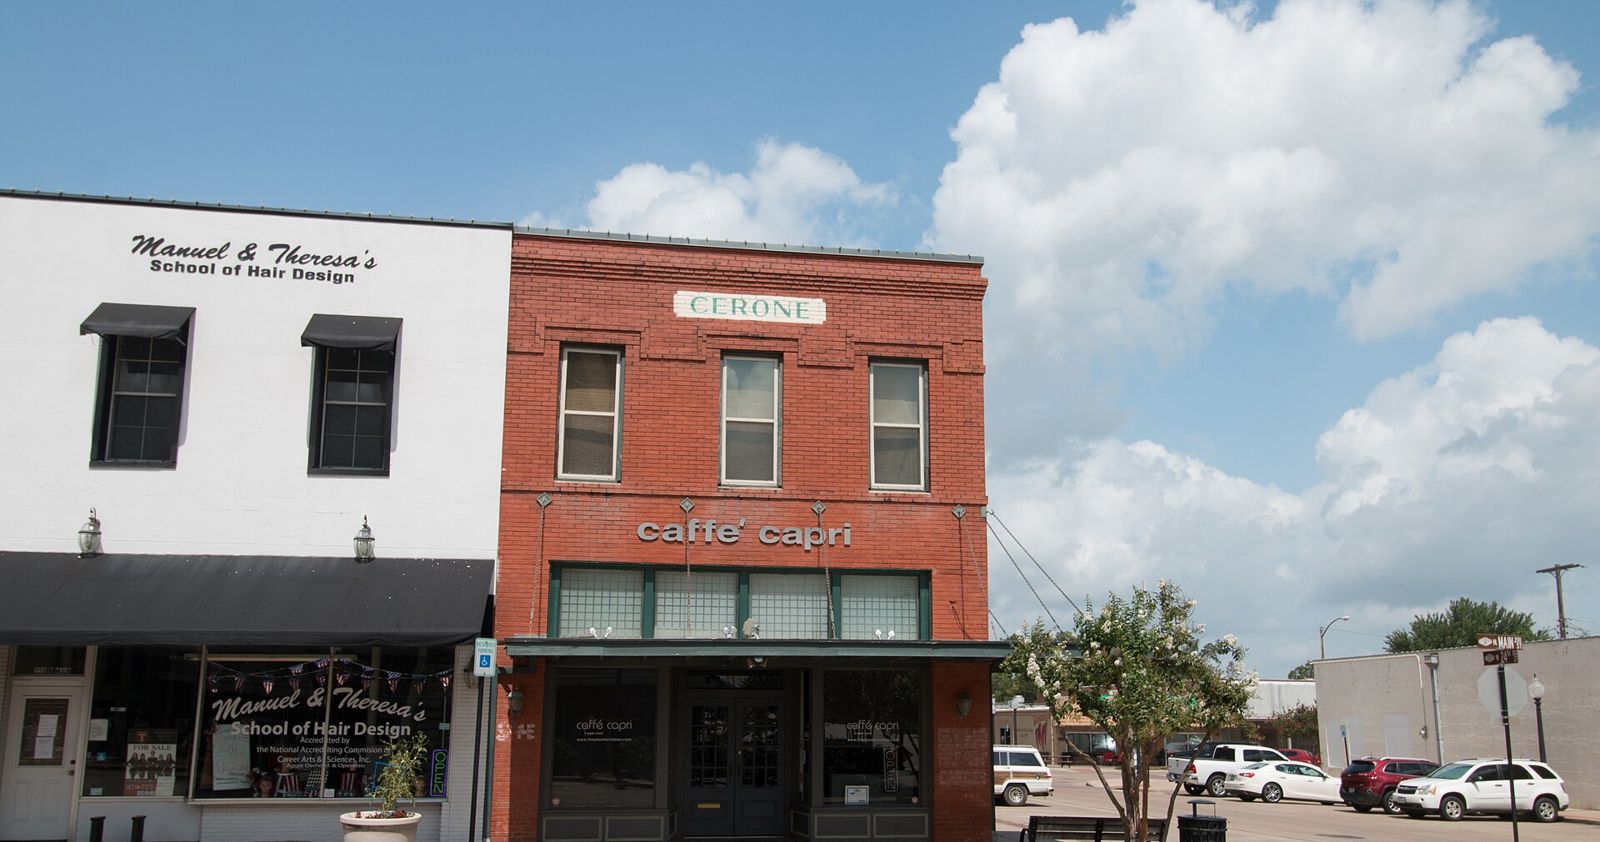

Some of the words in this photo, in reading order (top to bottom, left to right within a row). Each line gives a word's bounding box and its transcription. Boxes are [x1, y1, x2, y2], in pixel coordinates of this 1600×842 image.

[131, 234, 231, 260] Manuel
[237, 243, 258, 261] &
[268, 243, 378, 269] Theresa's
[150, 259, 215, 274] School
[222, 265, 242, 276] of
[248, 265, 286, 279] Hair
[293, 268, 355, 285] Design
[690, 295, 810, 320] CERONE
[759, 522, 852, 551] capri
[1498, 636, 1515, 649] MAIN
[212, 688, 300, 721] Manuel
[306, 687, 325, 707] &
[333, 687, 426, 721] Theresa's
[231, 721, 288, 735] School
[292, 721, 311, 735] of
[314, 722, 350, 735] Hair
[354, 722, 411, 739] Design
[606, 719, 633, 732] capri
[341, 737, 350, 745] by
[277, 755, 300, 763] Career
[301, 755, 316, 763] Arts
[886, 750, 897, 790] OPEN
[433, 751, 446, 794] OPEN
